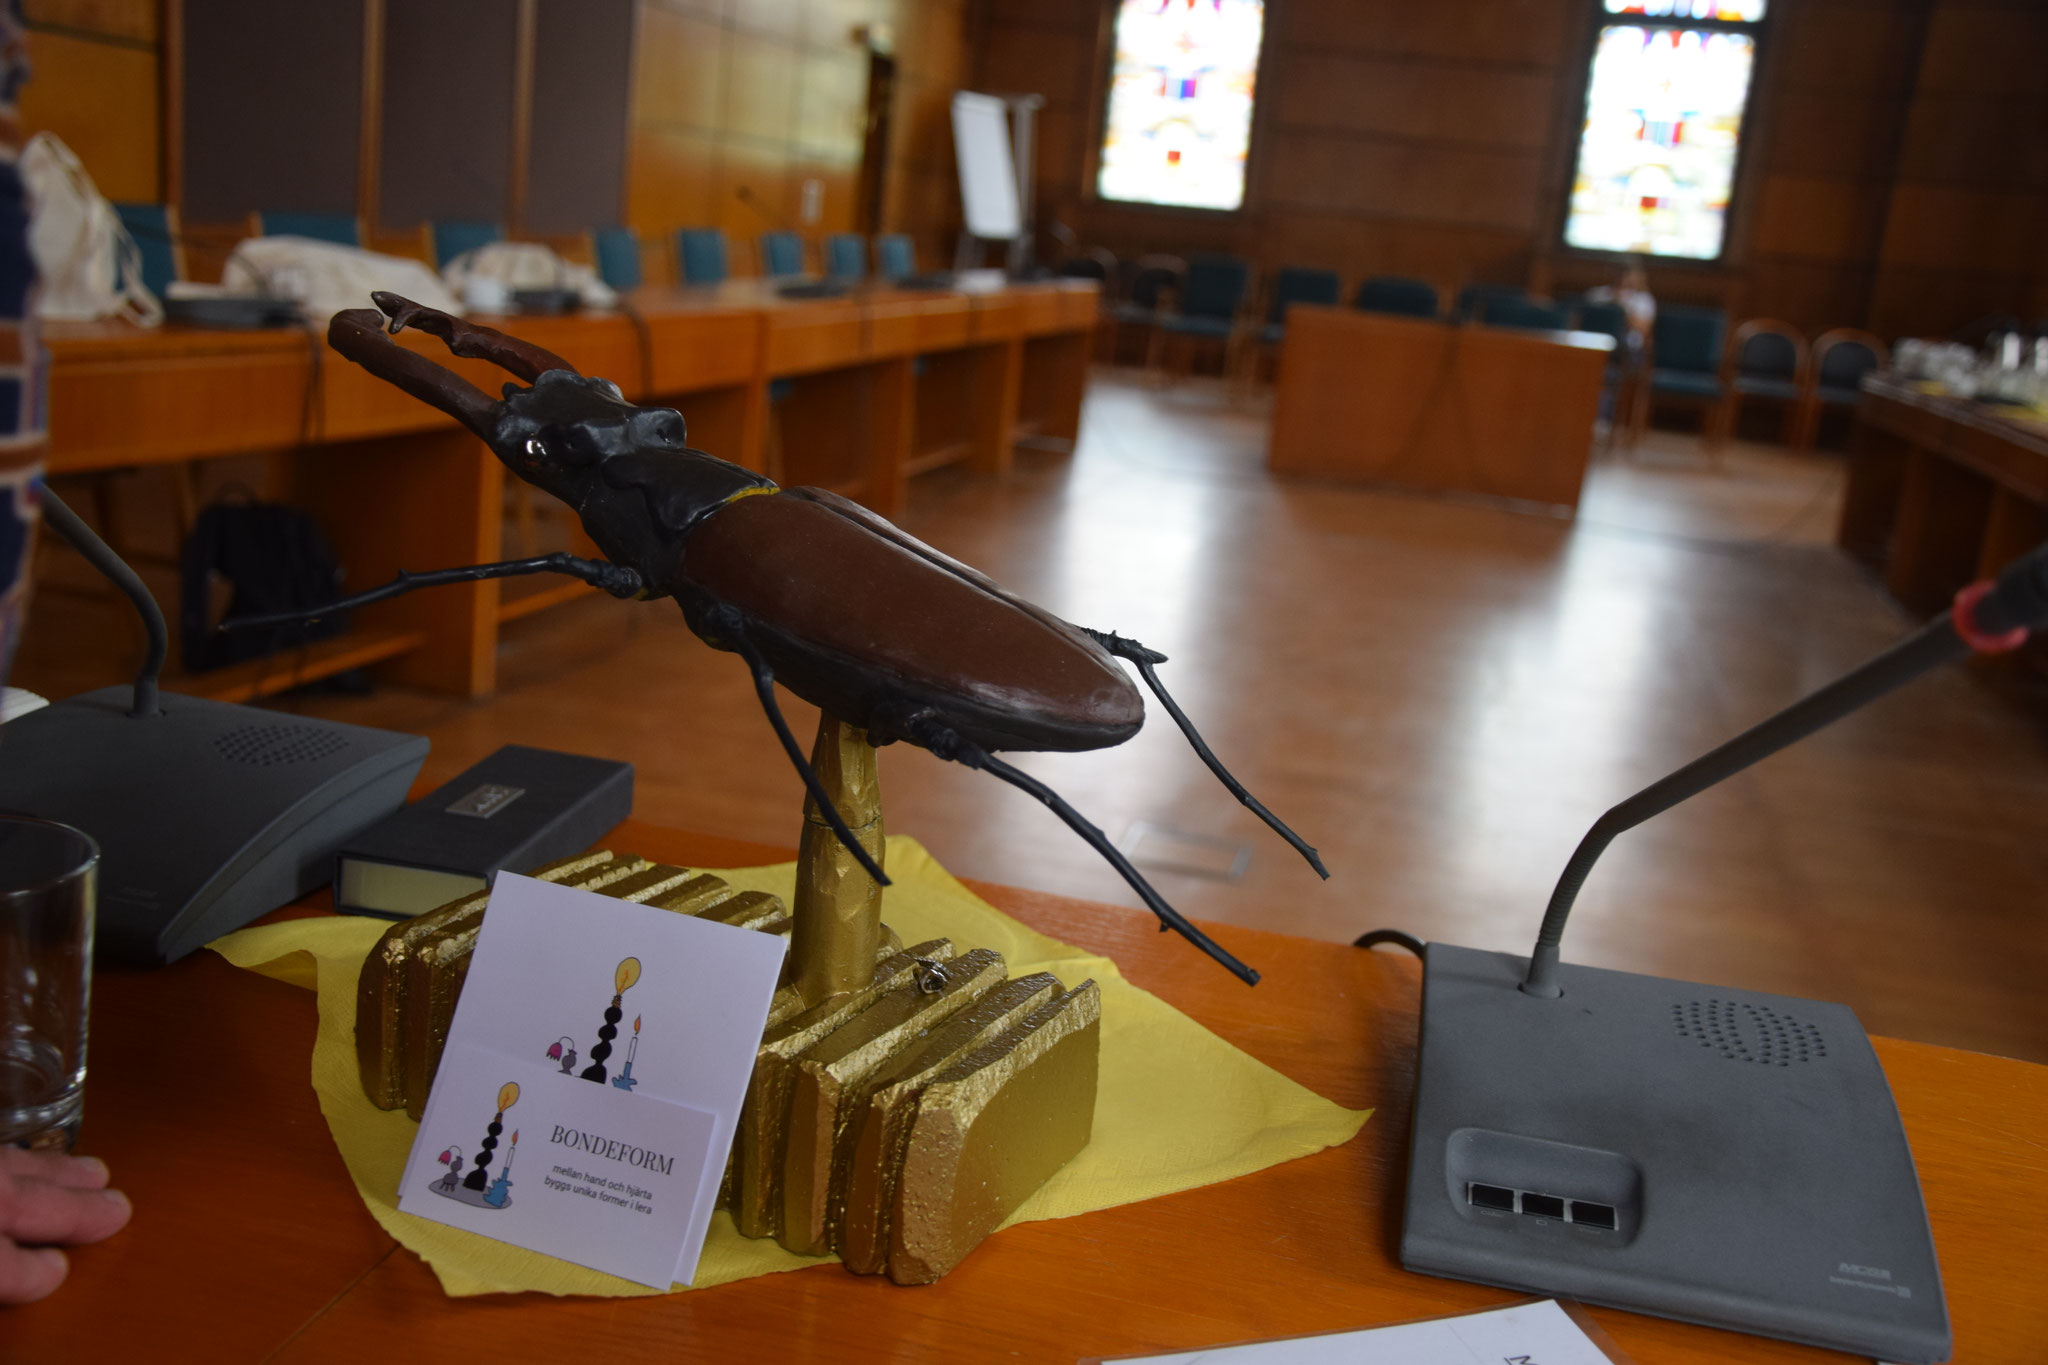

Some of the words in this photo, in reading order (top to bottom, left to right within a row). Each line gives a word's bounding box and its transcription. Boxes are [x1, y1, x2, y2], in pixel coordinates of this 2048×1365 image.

[550, 1124, 675, 1176] BONDEFORM
[544, 1175, 572, 1192] byggs
[573, 1185, 598, 1199] unika
[599, 1190, 629, 1209] former
[635, 1201, 653, 1215] lera
[552, 1165, 583, 1180] mellan
[584, 1171, 607, 1187] hand
[607, 1180, 625, 1193] och
[626, 1184, 653, 1201] hjärta
